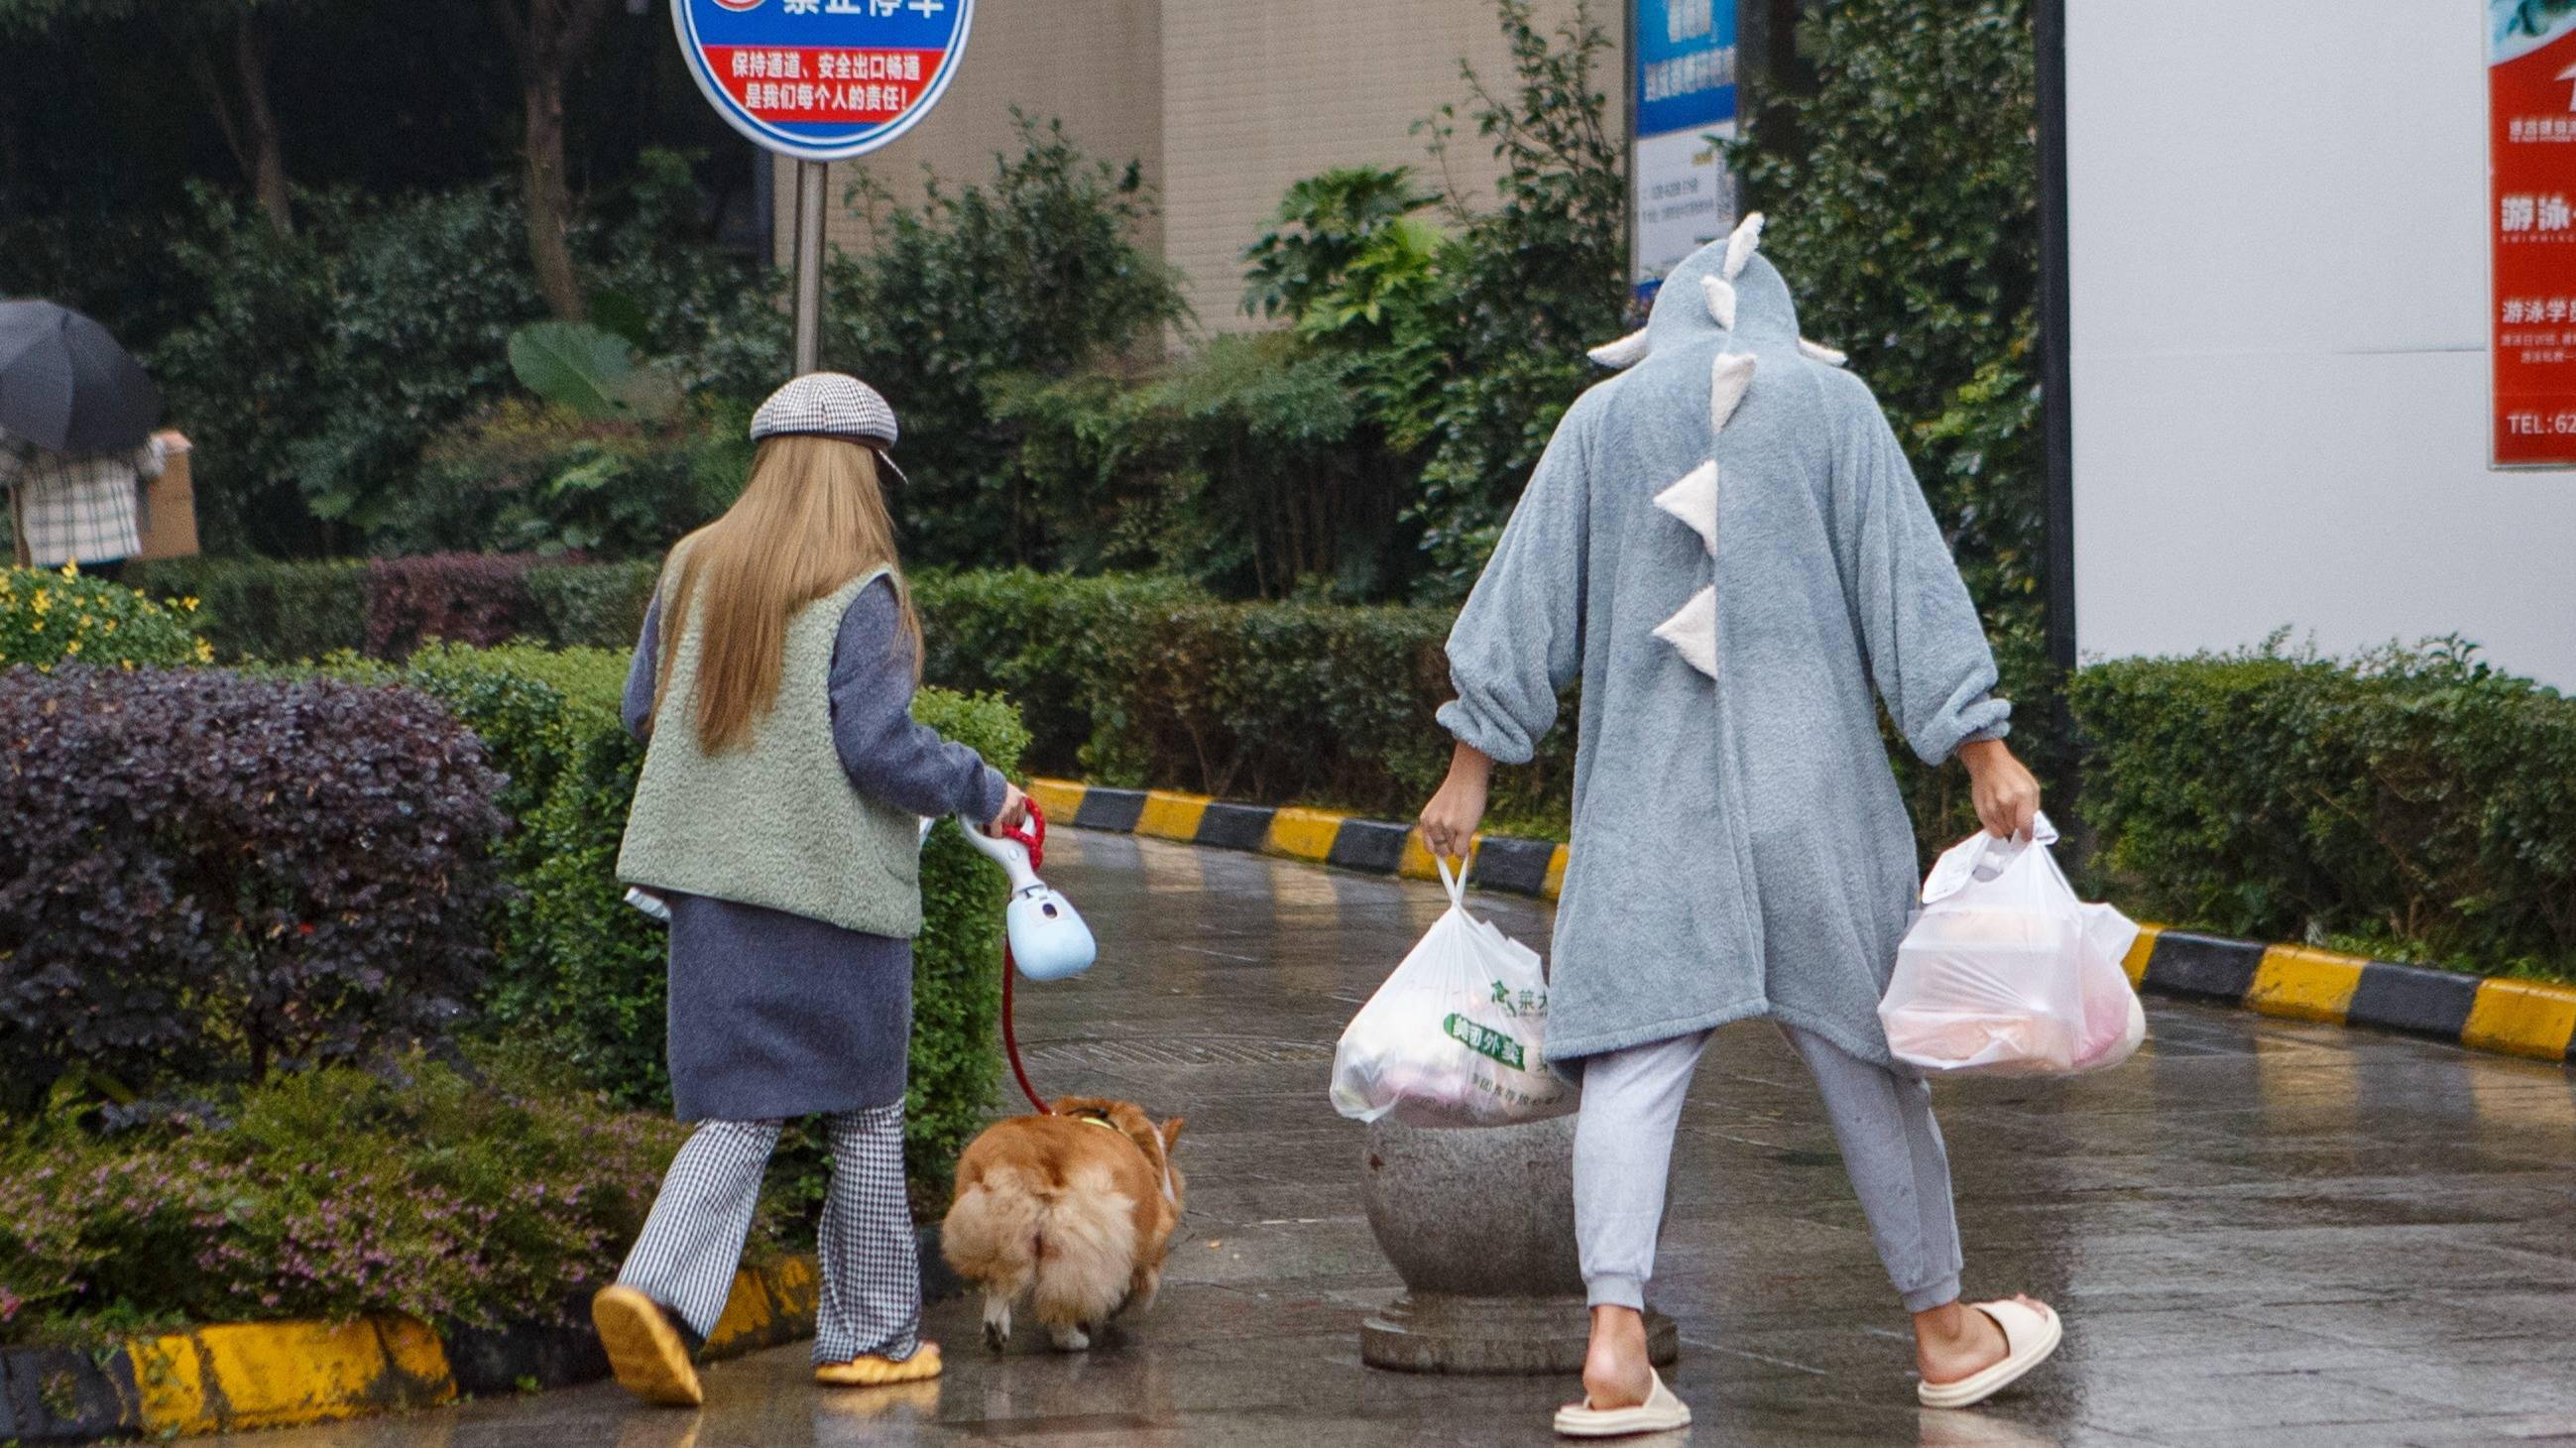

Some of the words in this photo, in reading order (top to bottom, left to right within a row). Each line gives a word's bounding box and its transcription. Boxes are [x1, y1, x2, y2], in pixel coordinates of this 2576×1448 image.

[732, 51, 920, 80] 保持通道、安全出口畅通
[2502, 196, 2576, 231] 游泳
